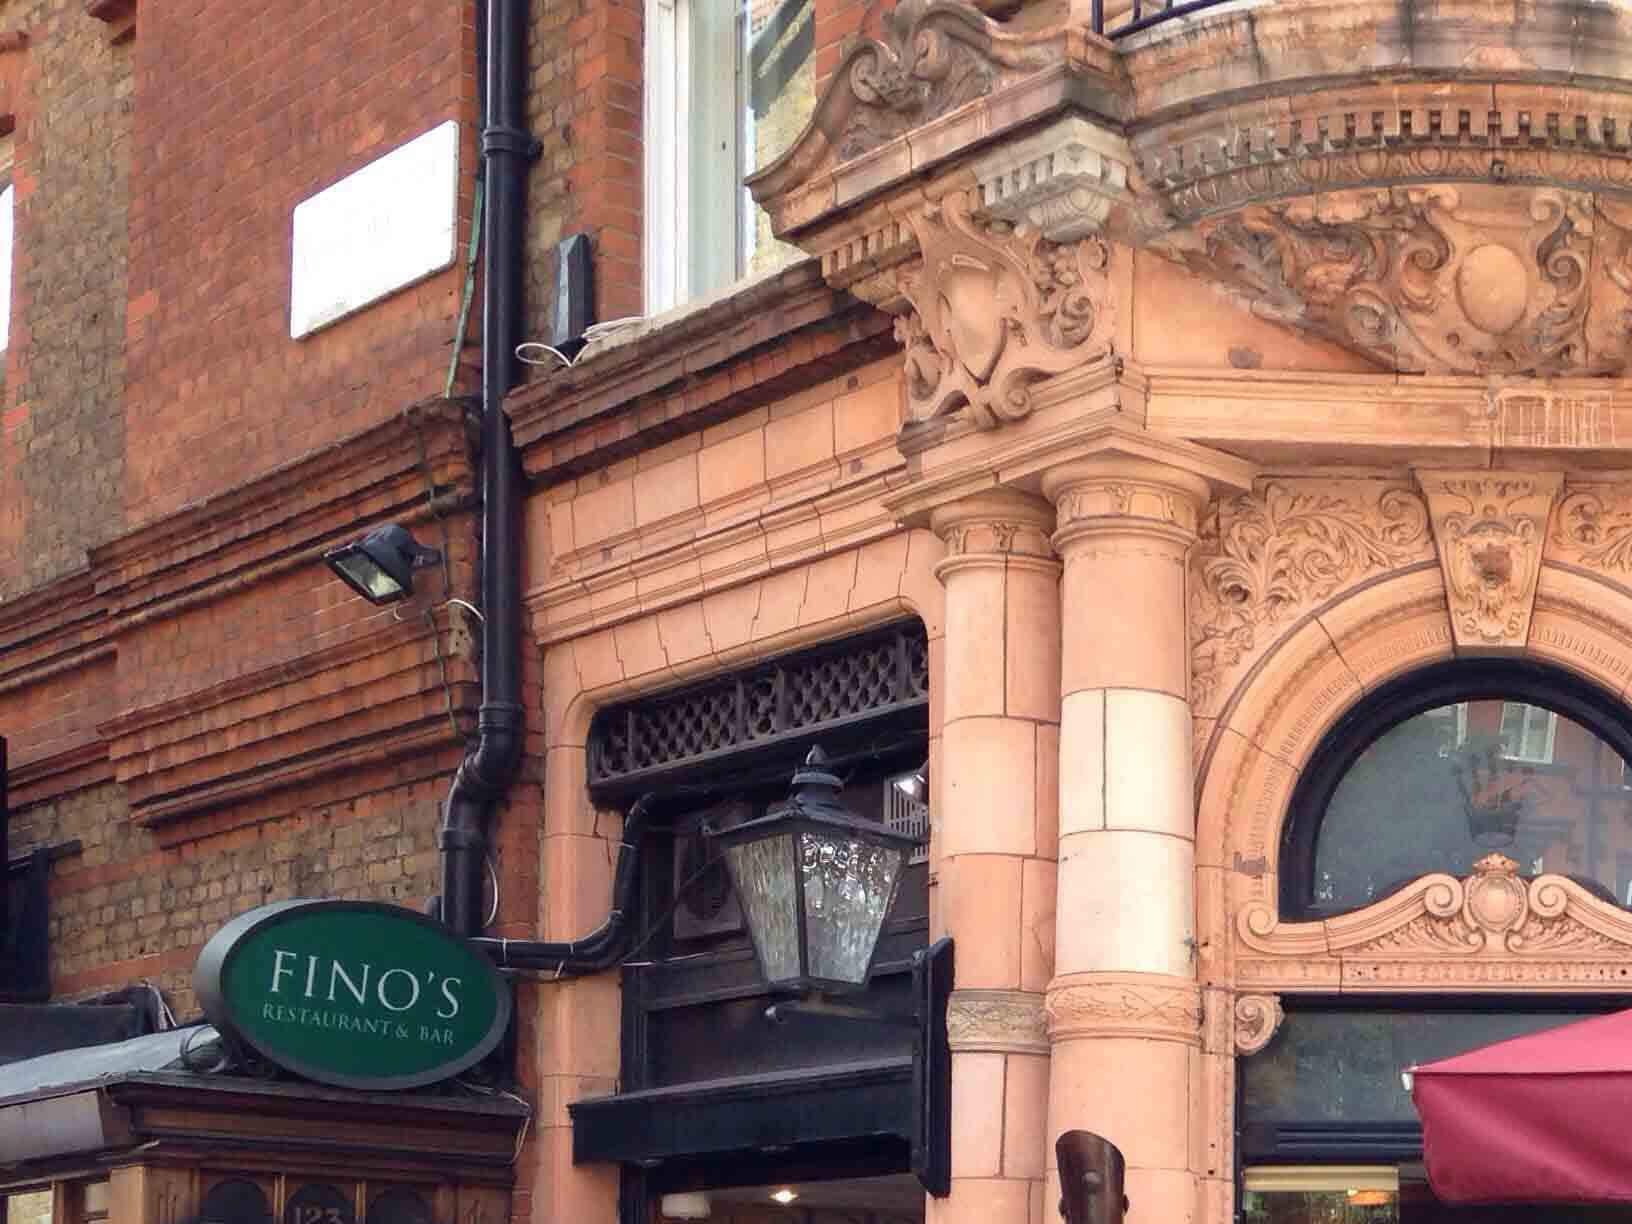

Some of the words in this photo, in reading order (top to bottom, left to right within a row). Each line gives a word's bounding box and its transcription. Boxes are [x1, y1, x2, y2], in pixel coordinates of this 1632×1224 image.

[269, 949, 462, 1019] FINO'S
[262, 1002, 392, 1037] RESTAURANT
[394, 1023, 409, 1039] &
[419, 1025, 454, 1045] BAR
